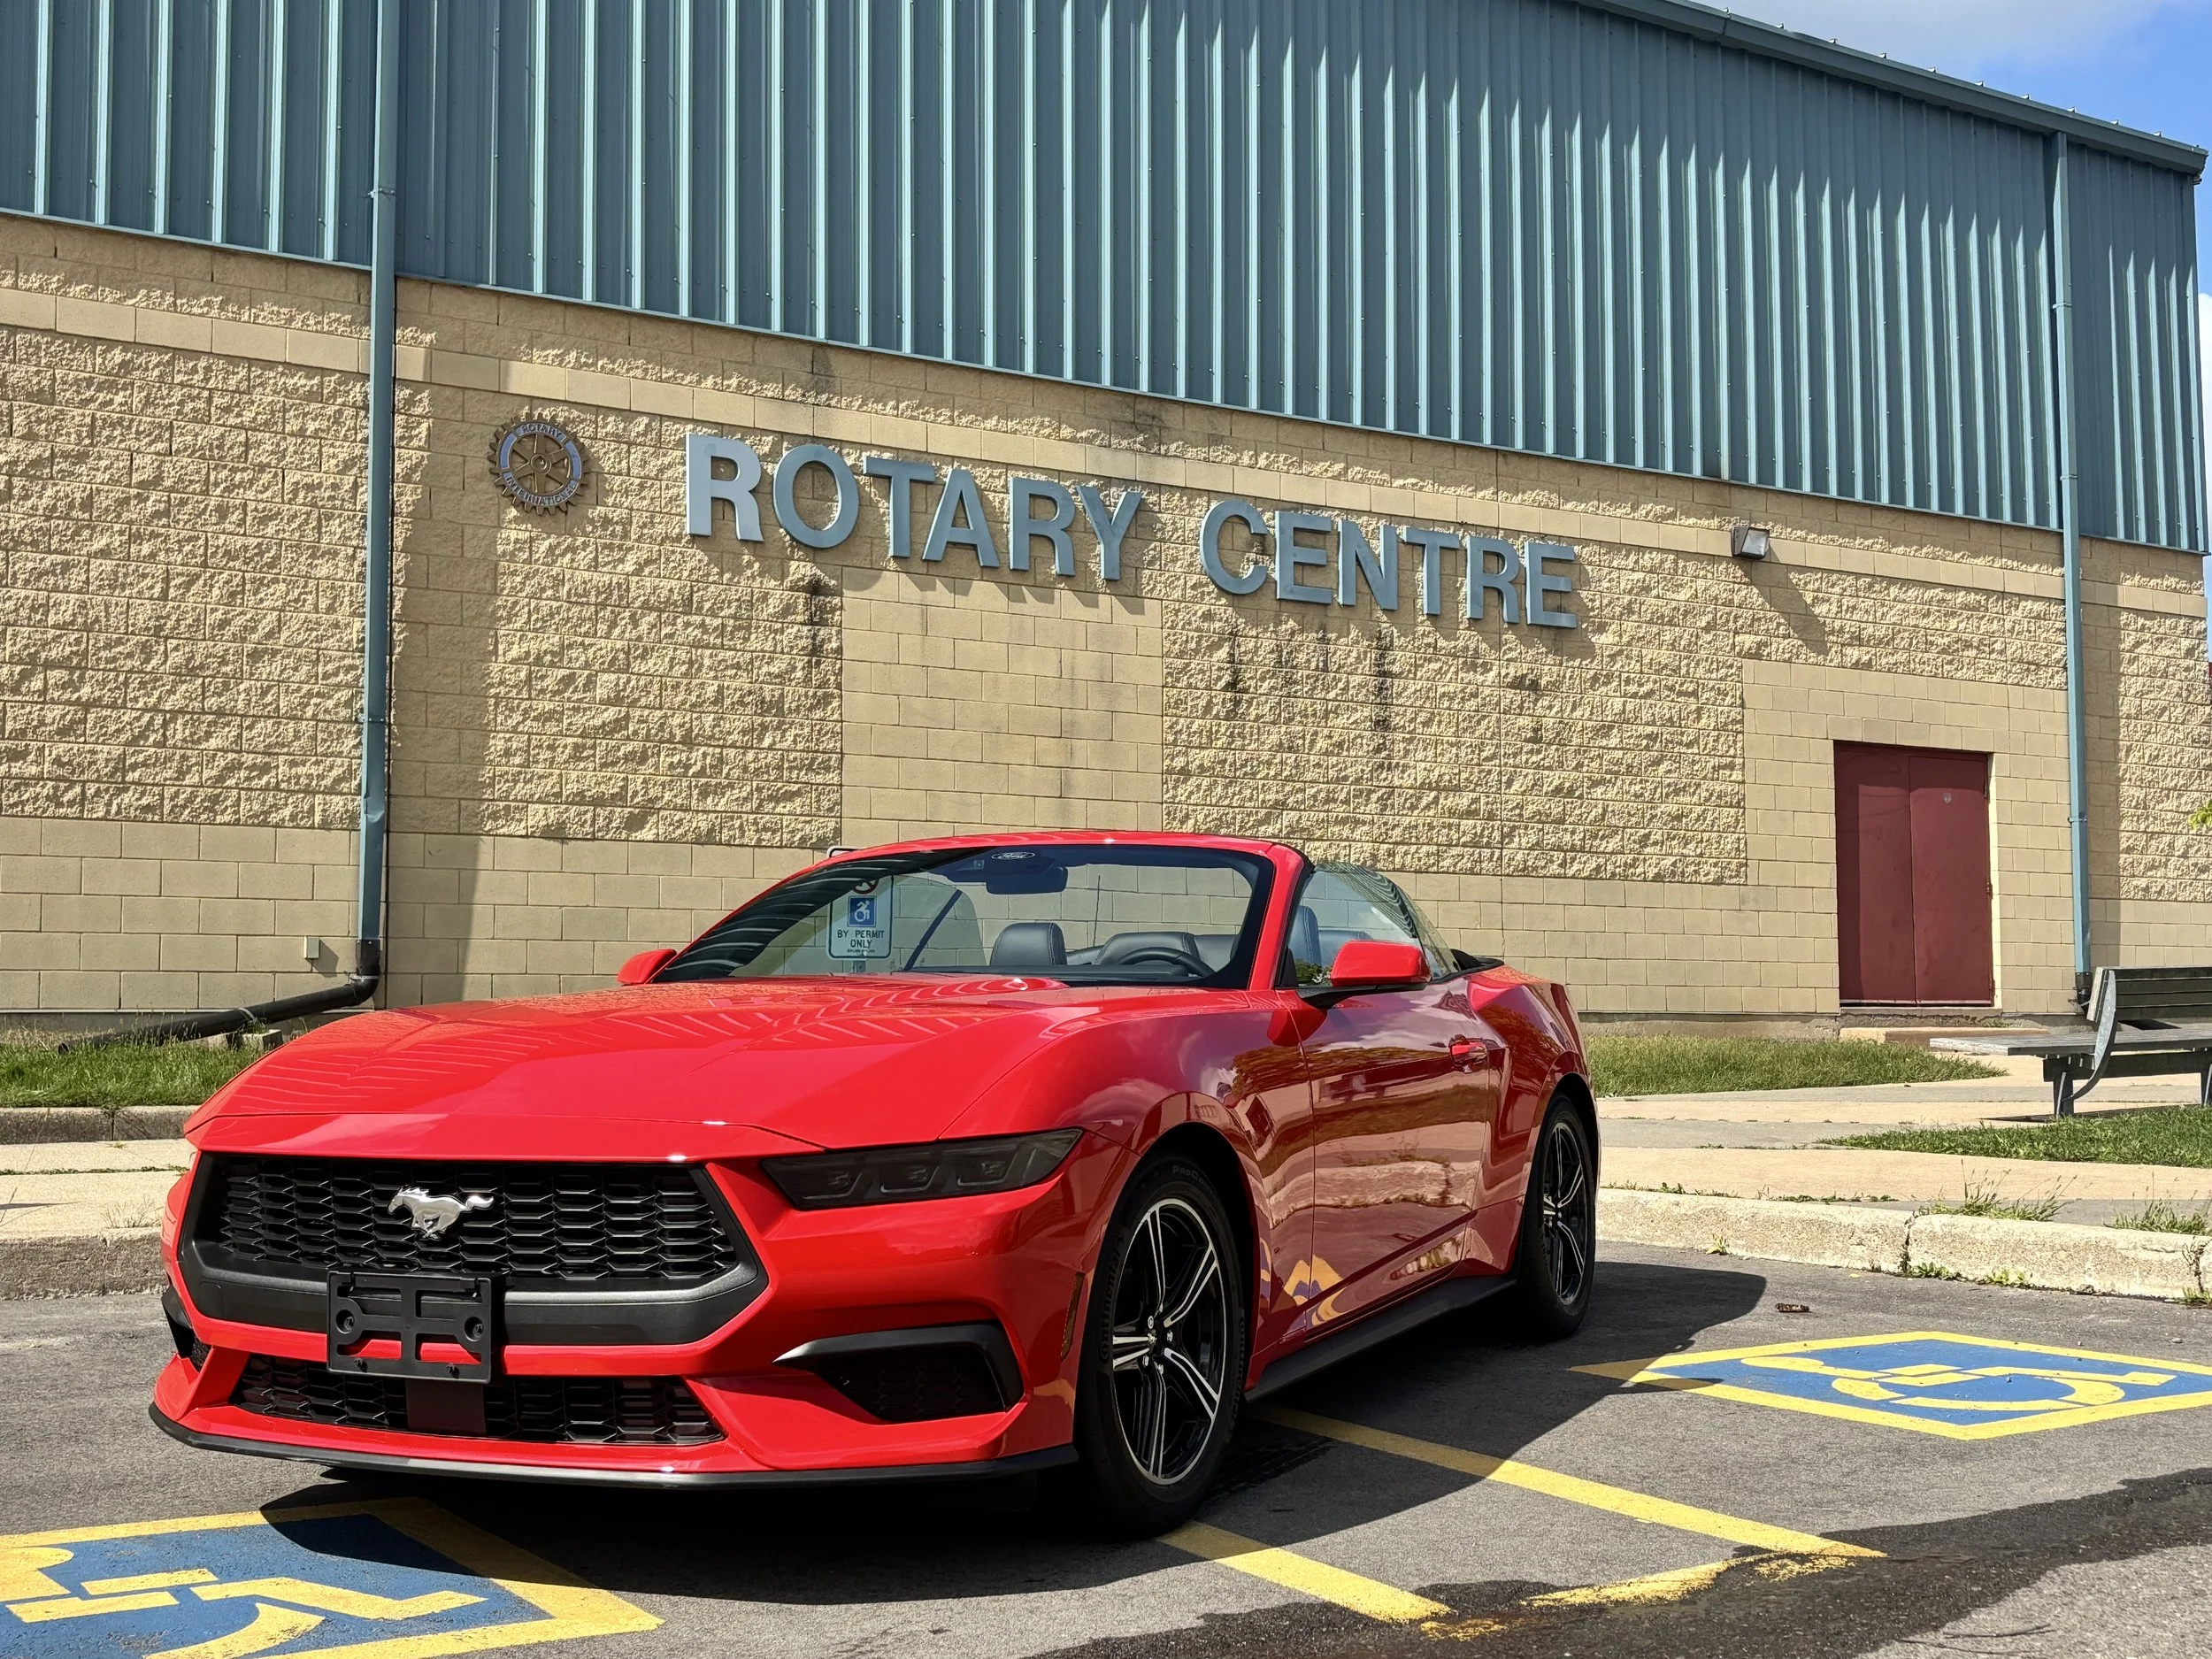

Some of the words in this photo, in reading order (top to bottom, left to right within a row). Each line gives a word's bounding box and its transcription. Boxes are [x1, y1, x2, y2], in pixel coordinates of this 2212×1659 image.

[522, 425, 564, 438] ROTARY
[505, 476, 577, 506] INTERNATIONAL
[686, 433, 1144, 581] ROTARY
[1200, 500, 1578, 629] CENTRE
[837, 929, 849, 939] BY
[855, 930, 885, 939] PERMIT
[849, 939, 873, 949] ONLY
